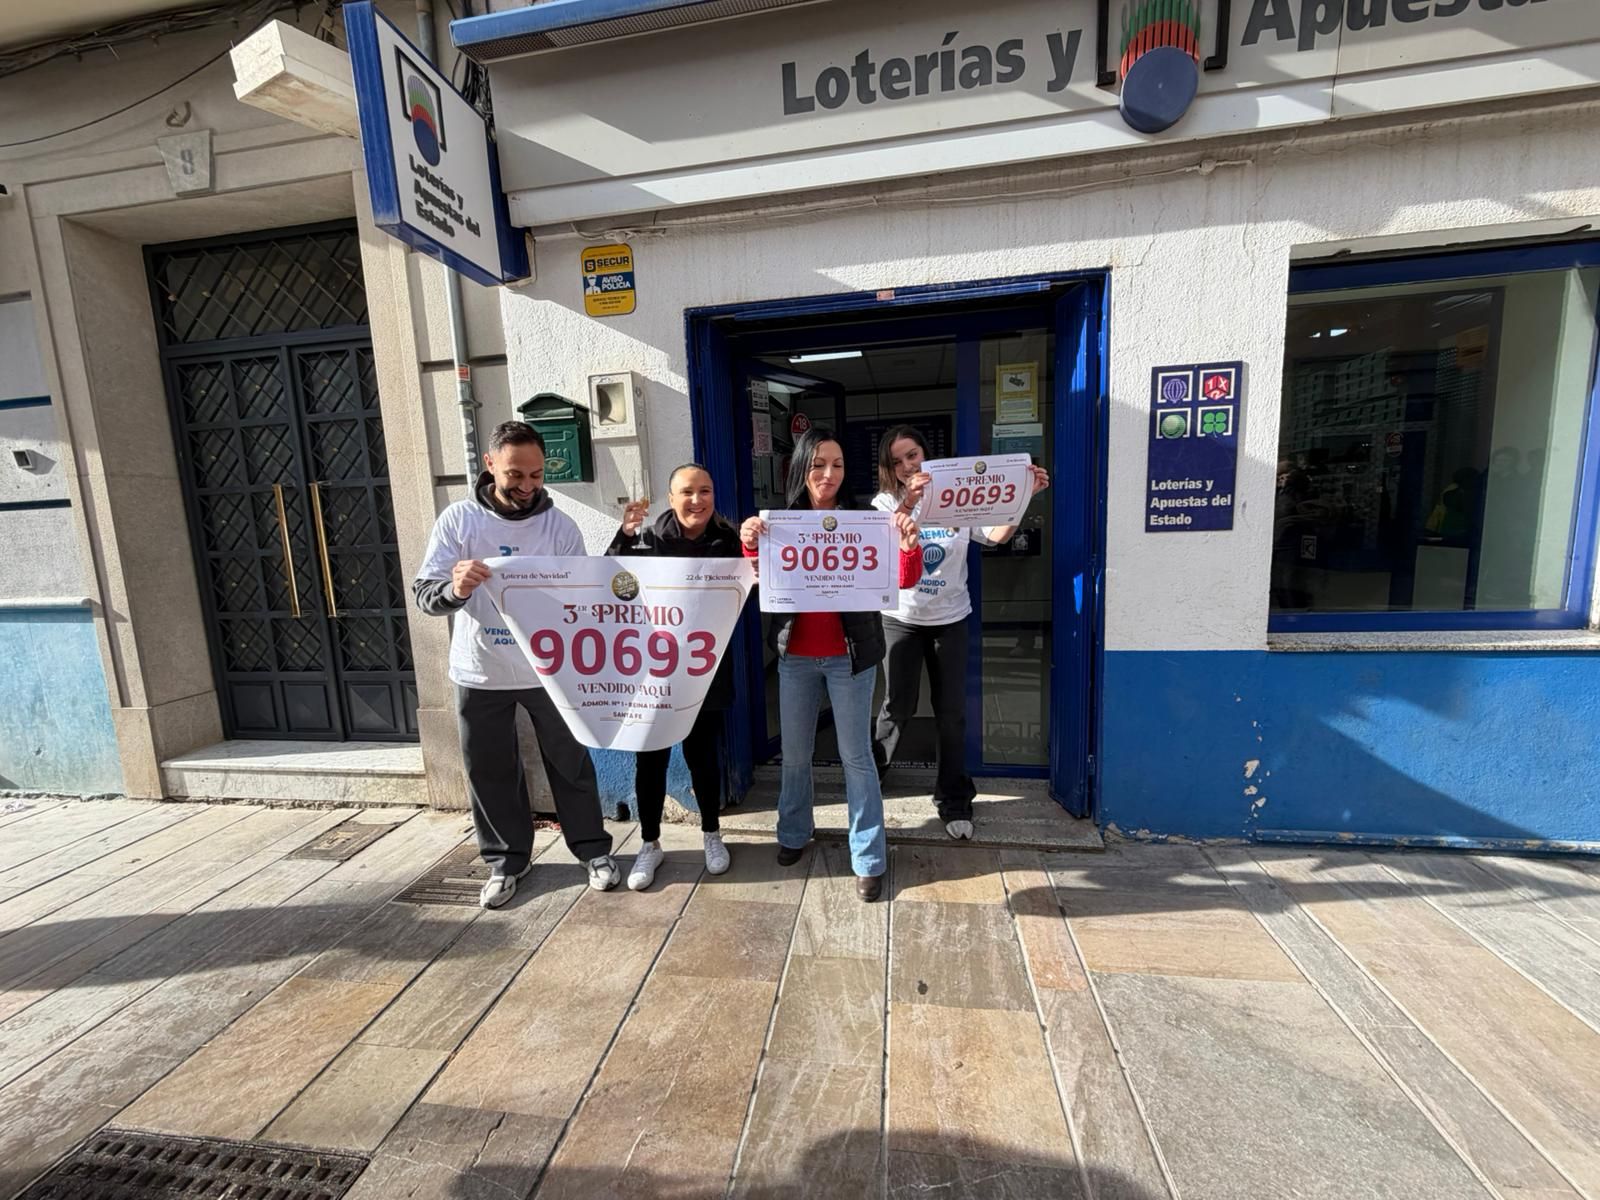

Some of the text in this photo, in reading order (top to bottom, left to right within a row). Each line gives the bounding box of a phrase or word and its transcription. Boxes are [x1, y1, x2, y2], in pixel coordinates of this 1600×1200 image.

[782, 31, 1026, 116] Loterías
[1046, 28, 1083, 93] y
[408, 153, 464, 211] Loterías y
[414, 178, 481, 238] Apuestas del
[415, 199, 455, 237] Estado
[597, 256, 630, 267] SECUR
[602, 275, 624, 285] AVISO
[1151, 478, 1214, 491] Loterías y
[940, 484, 1016, 509] 90693
[1150, 494, 1232, 511] Apuestas del
[1150, 513, 1192, 526] Estado
[811, 532, 862, 544] PREMIO
[781, 545, 879, 572] 90693
[591, 604, 684, 626] PREMIO
[529, 628, 717, 678] 90693
[577, 682, 672, 699] VENDIDO AQUÍ
[613, 711, 633, 719] SANTA
